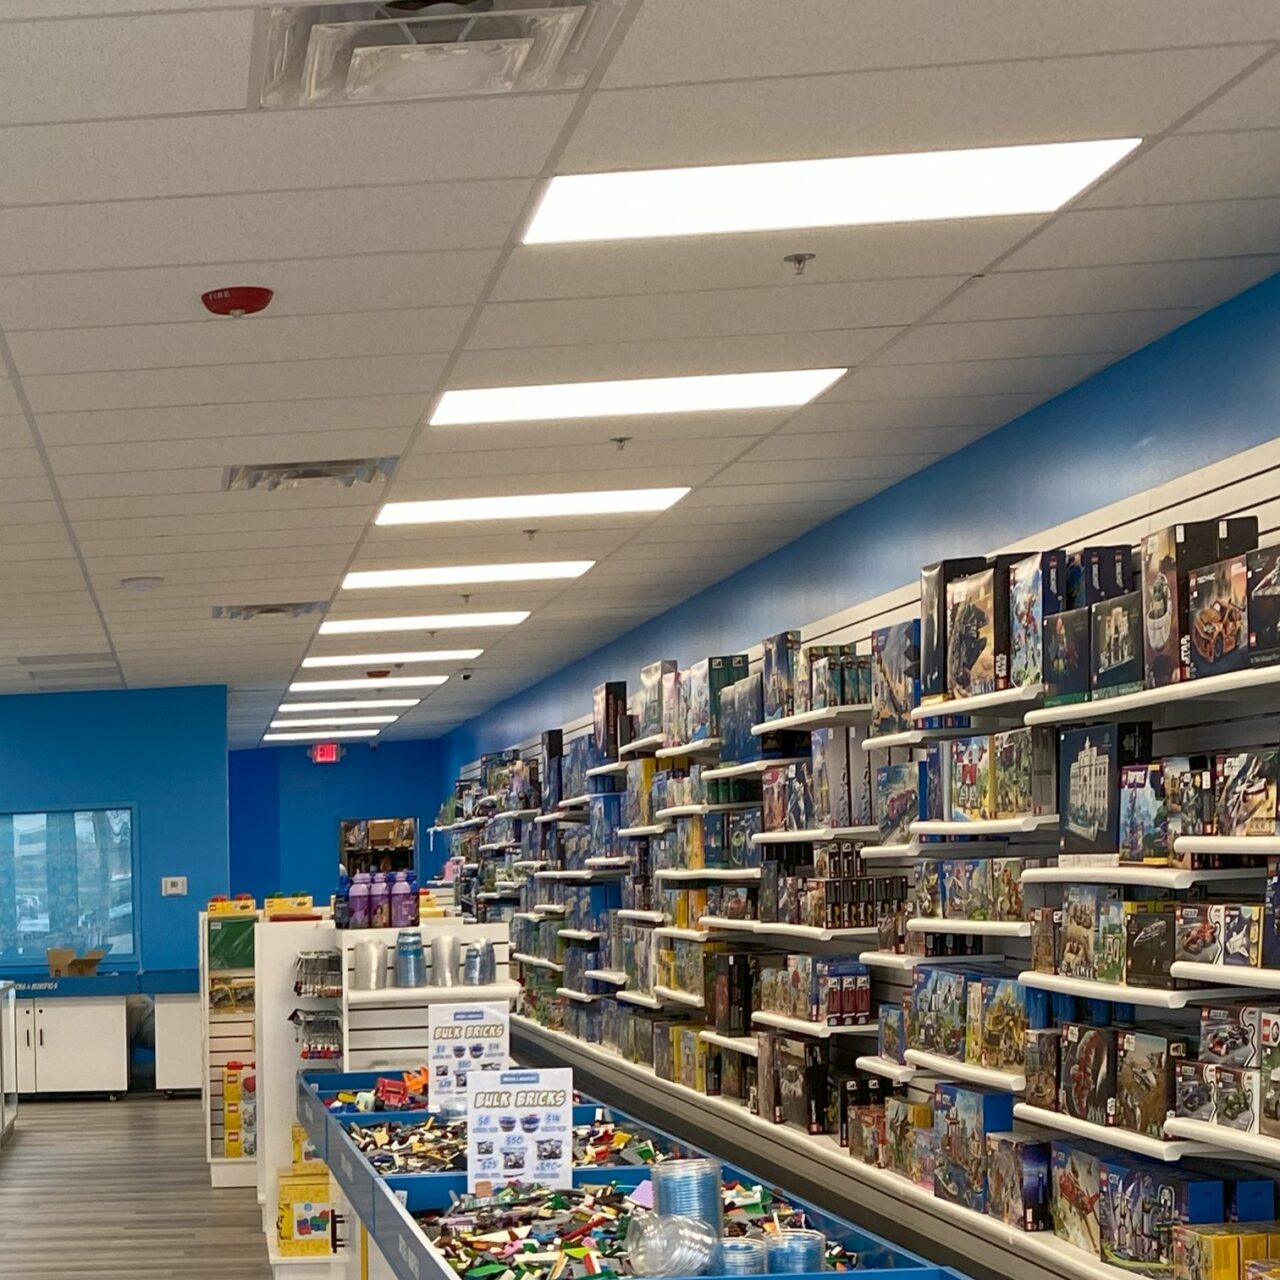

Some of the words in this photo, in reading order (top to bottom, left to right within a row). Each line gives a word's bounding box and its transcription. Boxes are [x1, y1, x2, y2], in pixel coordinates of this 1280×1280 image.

[433, 1026, 463, 1040] BULK
[465, 1024, 504, 1039] BRICKS
[474, 1091, 512, 1109] BULK
[515, 1089, 567, 1107] BRICKS
